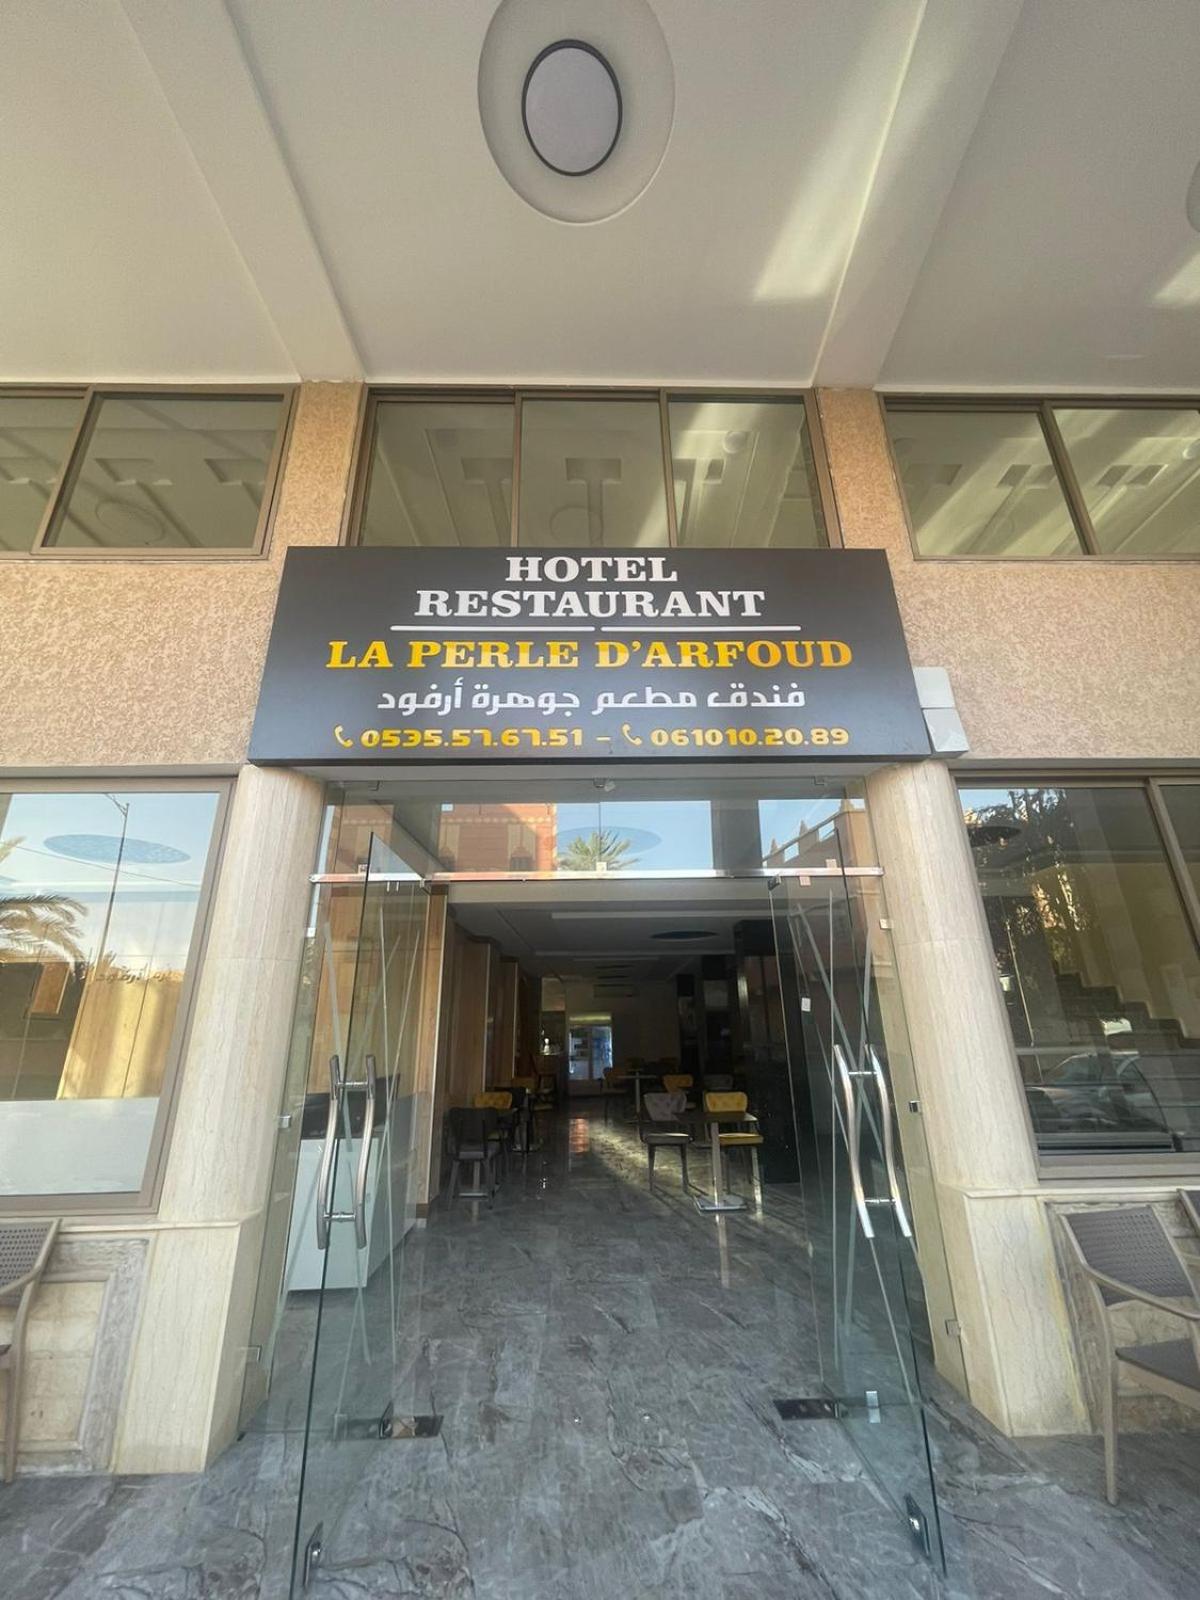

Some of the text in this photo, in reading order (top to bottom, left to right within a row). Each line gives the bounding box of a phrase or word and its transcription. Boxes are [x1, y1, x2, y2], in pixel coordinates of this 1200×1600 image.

[505, 556, 678, 583] HOTEL
[414, 590, 766, 618] RESTAURANT
[326, 640, 853, 669] LA PERLE D’ARFOUD
[377, 676, 806, 717] فندق مطعم جوهرة أرفود
[360, 728, 584, 747] 0535.57.67.51
[650, 727, 849, 746] 061010.20.89
